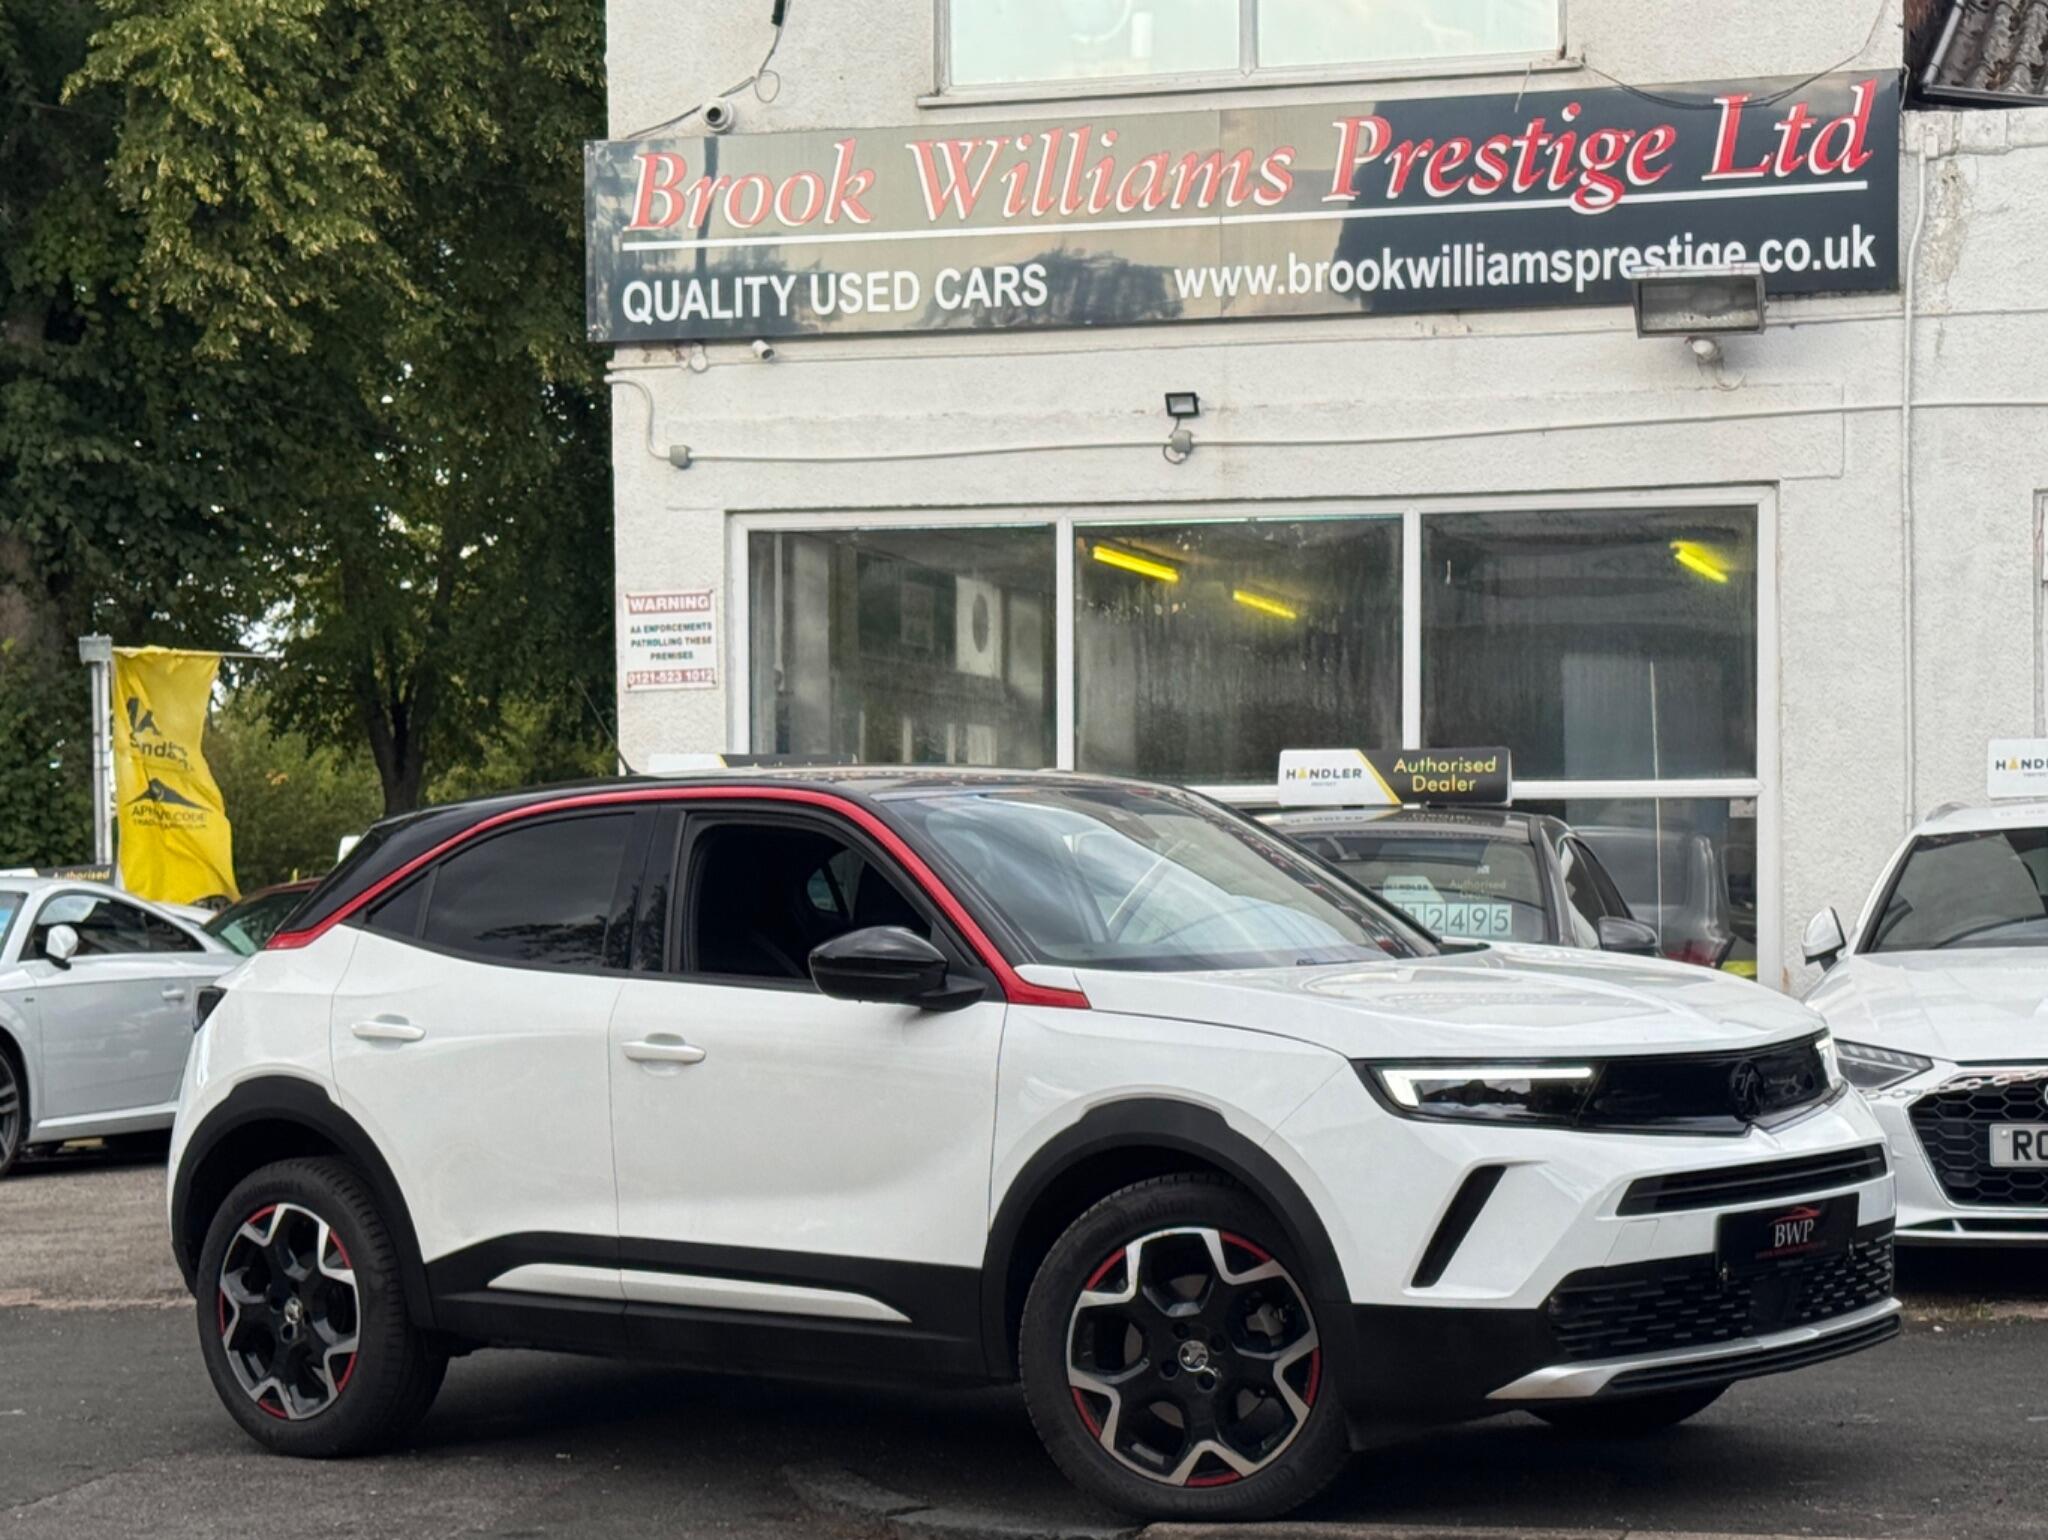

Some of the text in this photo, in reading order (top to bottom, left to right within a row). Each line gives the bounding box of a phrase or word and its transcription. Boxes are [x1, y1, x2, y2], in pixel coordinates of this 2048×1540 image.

[622, 77, 1879, 231] Brook Williams Prestige Ltd
[1174, 224, 1877, 299] www.brookwilliamsprestigeco.uk
[621, 264, 1048, 325] QUALITY USED CARS
[630, 595, 709, 611] WARNING
[631, 636, 712, 648] PATROLLING THESE
[650, 651, 693, 660] PREMISES
[1286, 766, 1362, 780] HANDLER
[1393, 755, 1497, 773] Authorised
[1412, 775, 1477, 793] Dealer
[1774, 1218, 1815, 1248] BWP
